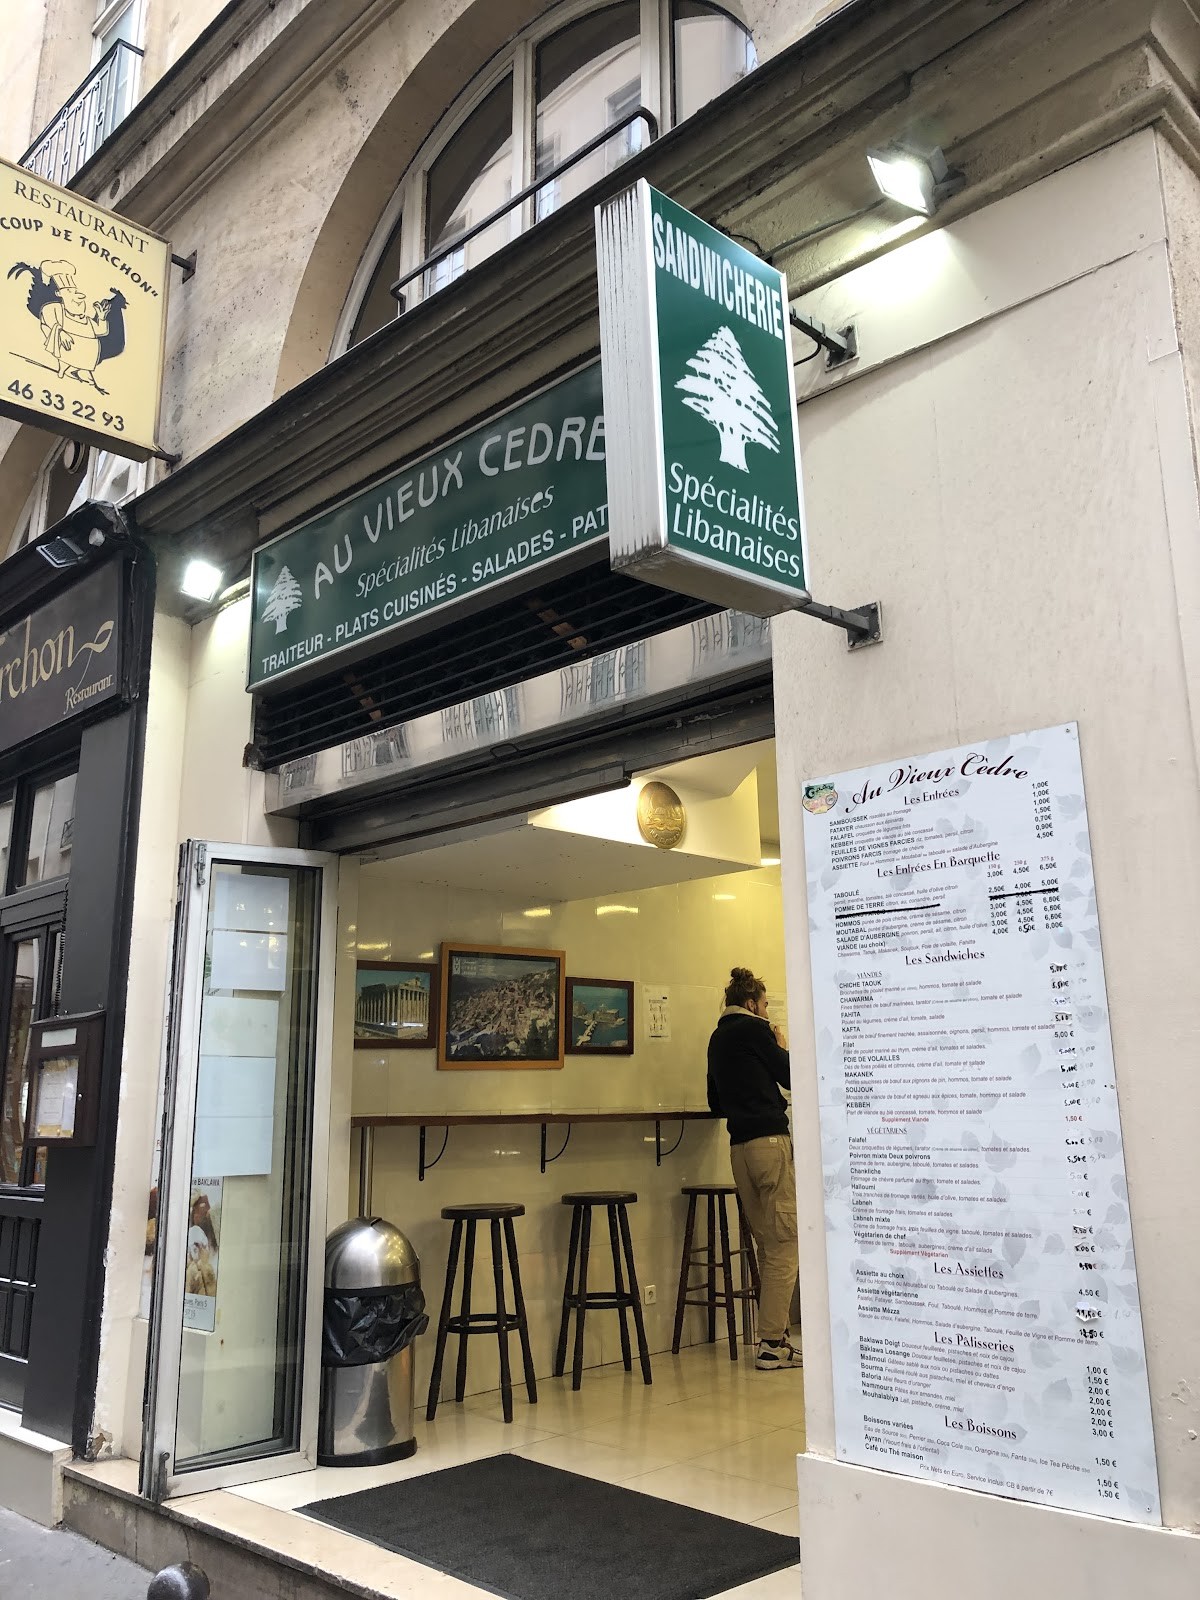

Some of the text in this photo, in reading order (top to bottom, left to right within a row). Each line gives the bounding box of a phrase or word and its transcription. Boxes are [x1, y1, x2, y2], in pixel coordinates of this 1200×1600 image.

[14, 179, 149, 253] RESTAURANT
[0, 217, 43, 232] COUP
[51, 226, 72, 242] DE
[653, 212, 783, 340] SANDWICHERIE
[8, 380, 124, 432] 46 33 22 93
[668, 461, 798, 541] Spécialités
[314, 416, 604, 600] AU VIEUX CEDRE
[355, 483, 555, 598] Spécialités Libanaises
[672, 503, 800, 578] Libanaises
[262, 633, 323, 675] TRAITEUR
[335, 607, 380, 640] PLATS
[383, 573, 456, 622] CUISINÉS
[471, 530, 554, 576] SALADES
[845, 780, 883, 814] Au
[887, 765, 956, 793] Vieux
[960, 752, 1029, 780] Cèdre
[1032, 781, 1048, 789] 1,00€
[904, 789, 959, 805] Les Entrées
[1033, 789, 1049, 797] 1,00€
[1034, 797, 1050, 806] 1,00€
[1034, 806, 1051, 814] 1,50€
[830, 825, 854, 834] FATAYER
[830, 833, 854, 841] FALAFEL
[1037, 831, 1053, 839] 4,50€
[831, 840, 854, 848] KEBBEH
[831, 847, 857, 856] FEUILLES
[890, 838, 915, 846] FARCIES
[832, 854, 860, 863] POIVRONS
[832, 862, 858, 871] ASSIETTE
[877, 852, 1000, 878] Les Entrées En Barquette
[1042, 878, 1058, 886] 5,00€
[906, 948, 985, 965] Les Sandwiches
[934, 1262, 1004, 1279] Les Assiettes
[858, 1305, 881, 1313] Assiette
[860, 1336, 883, 1344] Baklawa
[935, 1332, 1014, 1352] Les Pâtisseries
[860, 1344, 884, 1354] Baklawa
[1087, 1366, 1102, 1374] 1,00
[1088, 1376, 1102, 1385] 1,50
[1088, 1386, 1104, 1395] 2,00
[864, 1415, 891, 1426] Boissons
[945, 1416, 1016, 1439] Les Boissons
[1092, 1428, 1108, 1437] 3,00
[865, 1434, 882, 1443] Ayran
[865, 1443, 878, 1452] Café
[902, 1452, 924, 1460] maison
[1096, 1458, 1110, 1466] 1,50
